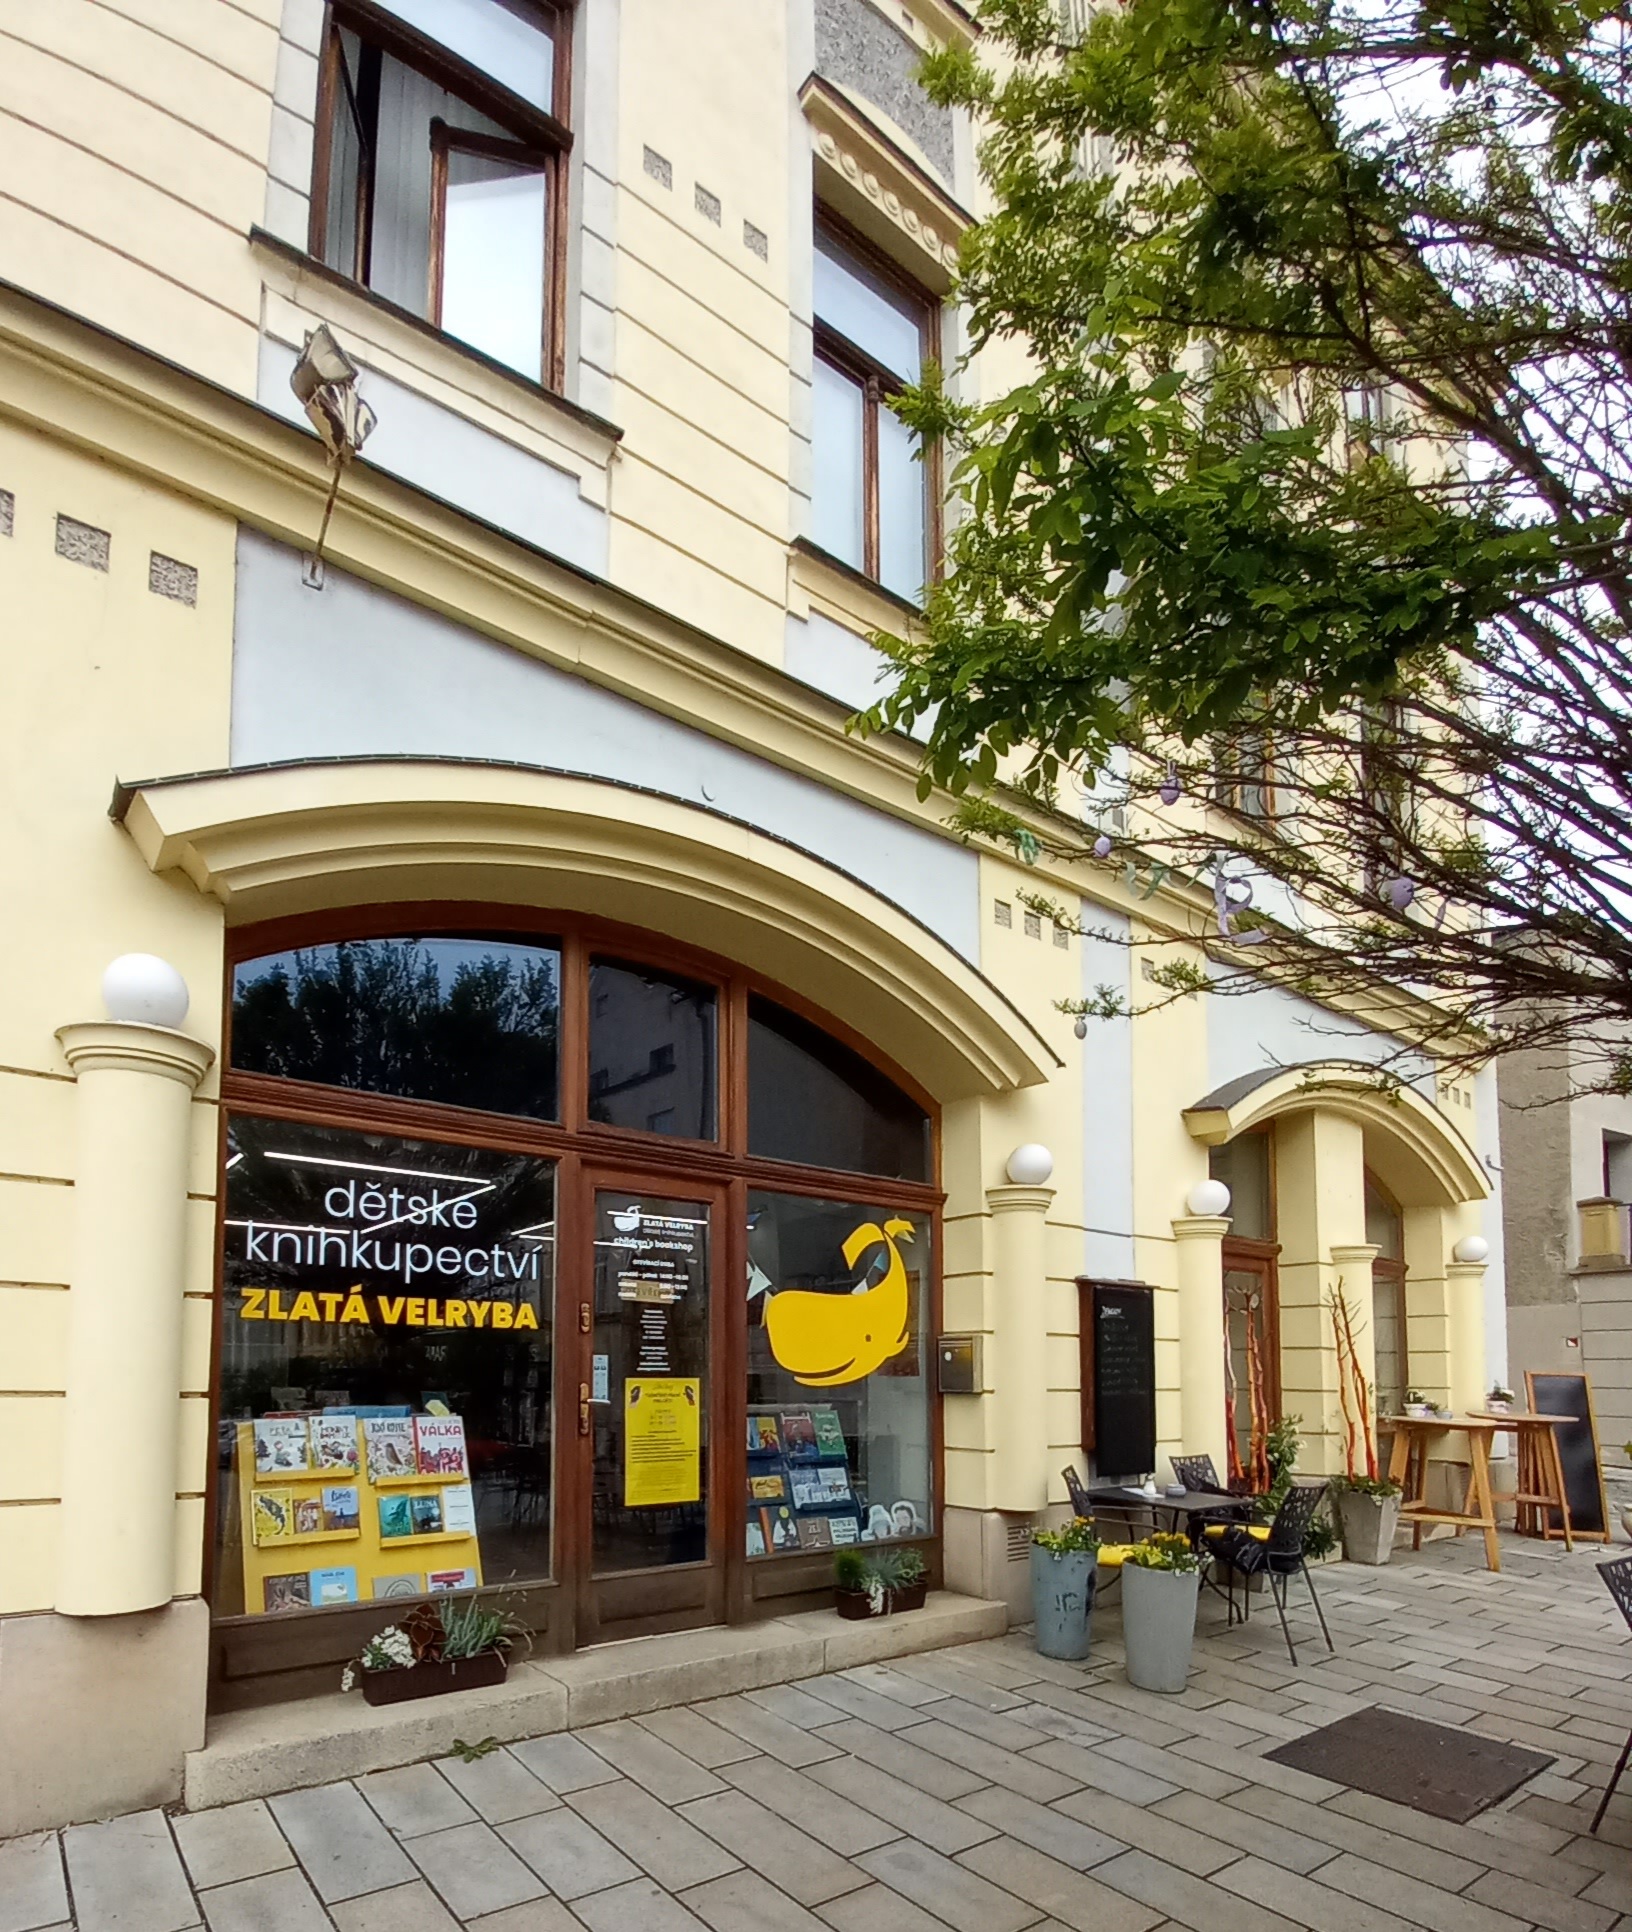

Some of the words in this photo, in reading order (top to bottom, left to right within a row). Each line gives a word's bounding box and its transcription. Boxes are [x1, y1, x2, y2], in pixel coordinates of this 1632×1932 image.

[246, 1219, 543, 1284] knihkupectví
[240, 1283, 370, 1324] ZLATÁ
[377, 1295, 539, 1330] VELRYBA
[419, 1422, 462, 1436] VÁLKA
